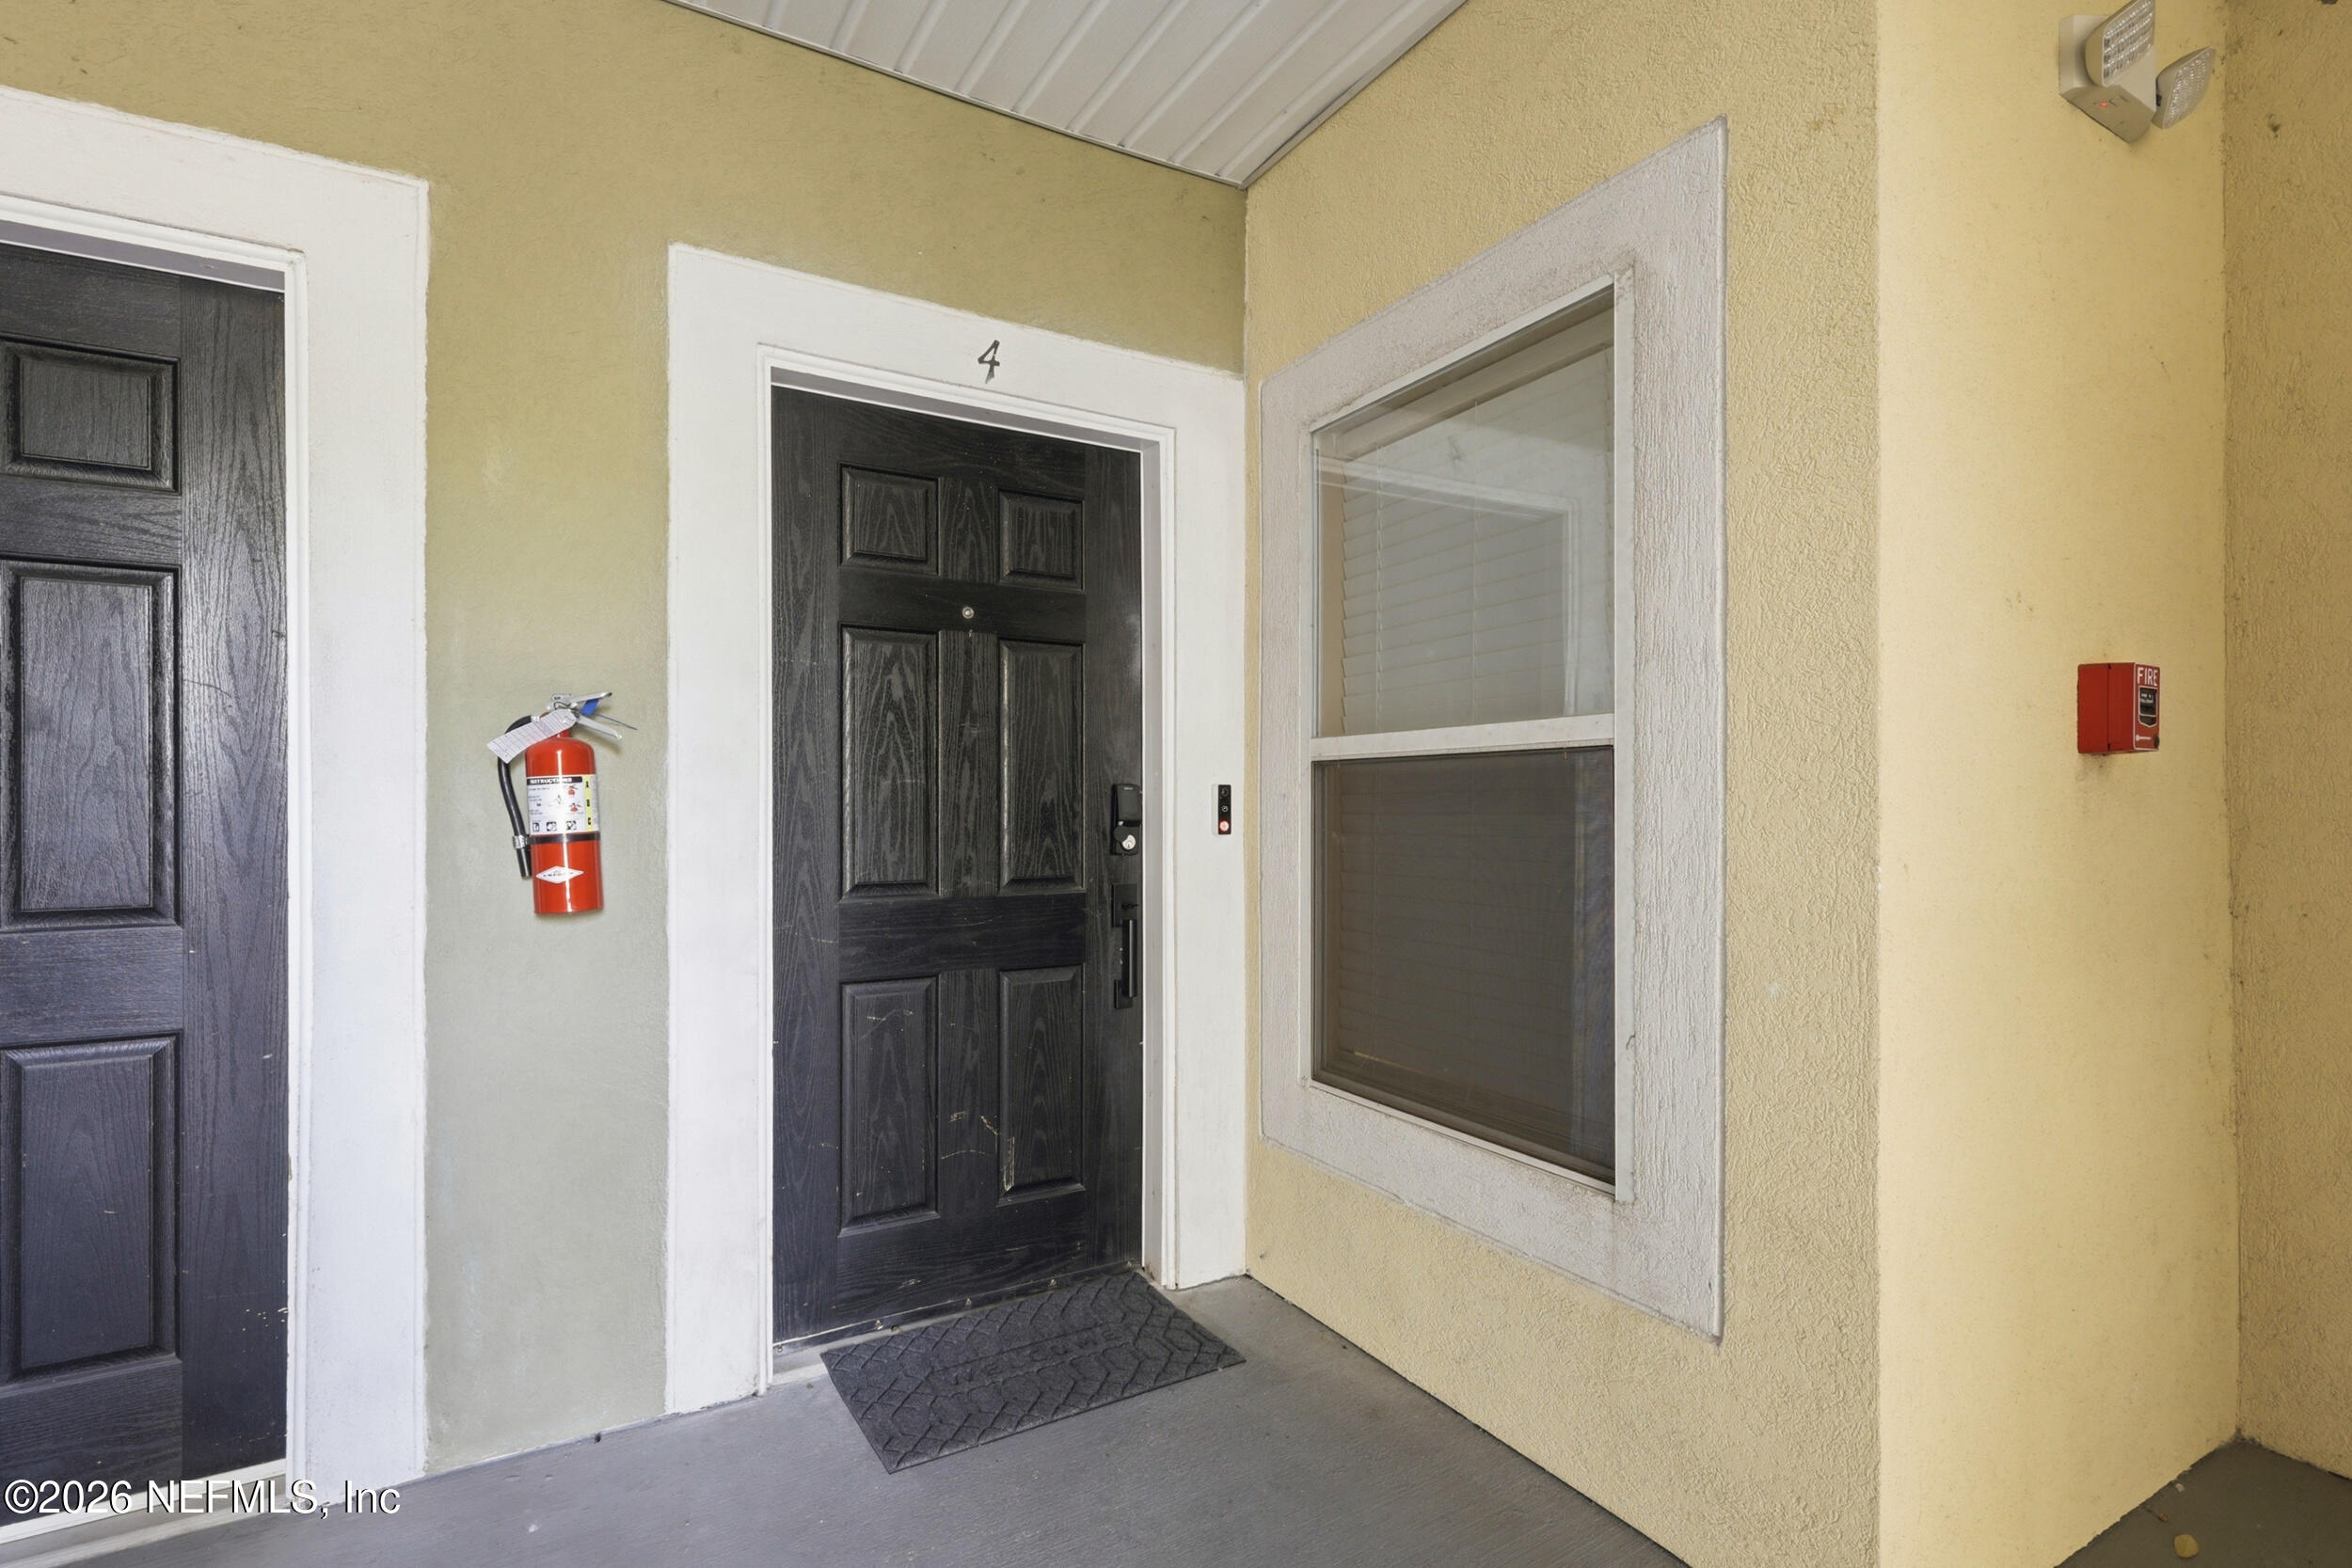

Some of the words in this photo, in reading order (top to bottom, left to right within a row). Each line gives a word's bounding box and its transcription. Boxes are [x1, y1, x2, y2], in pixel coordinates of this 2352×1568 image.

[977, 340, 1000, 384] 4
[2137, 667, 2158, 687] FIRE
[953, 1327, 1124, 1386] WELCOME
